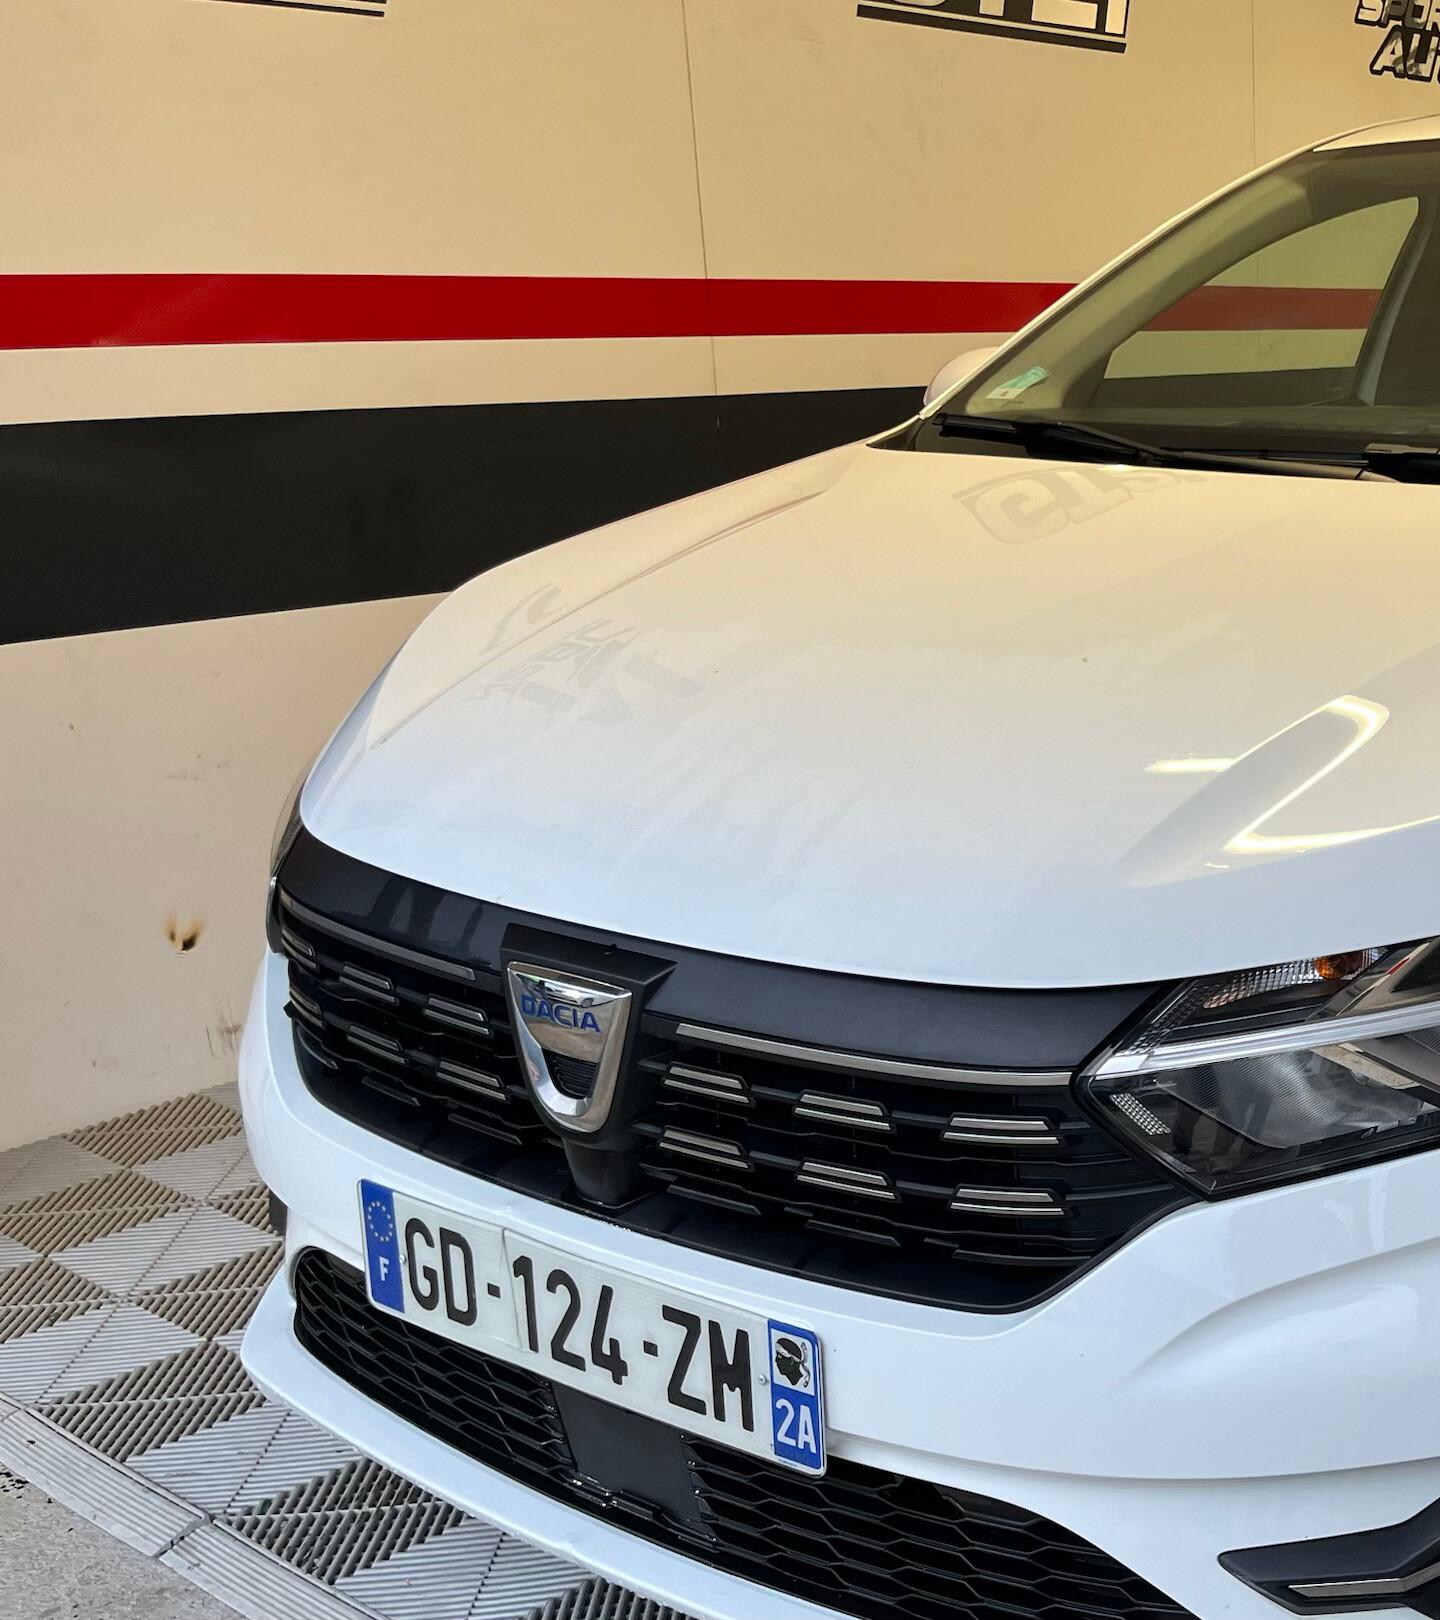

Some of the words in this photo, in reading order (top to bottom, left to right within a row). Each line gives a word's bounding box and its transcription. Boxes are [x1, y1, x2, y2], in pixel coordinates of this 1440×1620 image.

[521, 994, 602, 1034] DACIA
[378, 1256, 390, 1282] F
[404, 1217, 754, 1433] GD-124-ZM
[775, 1398, 817, 1454] 2A
